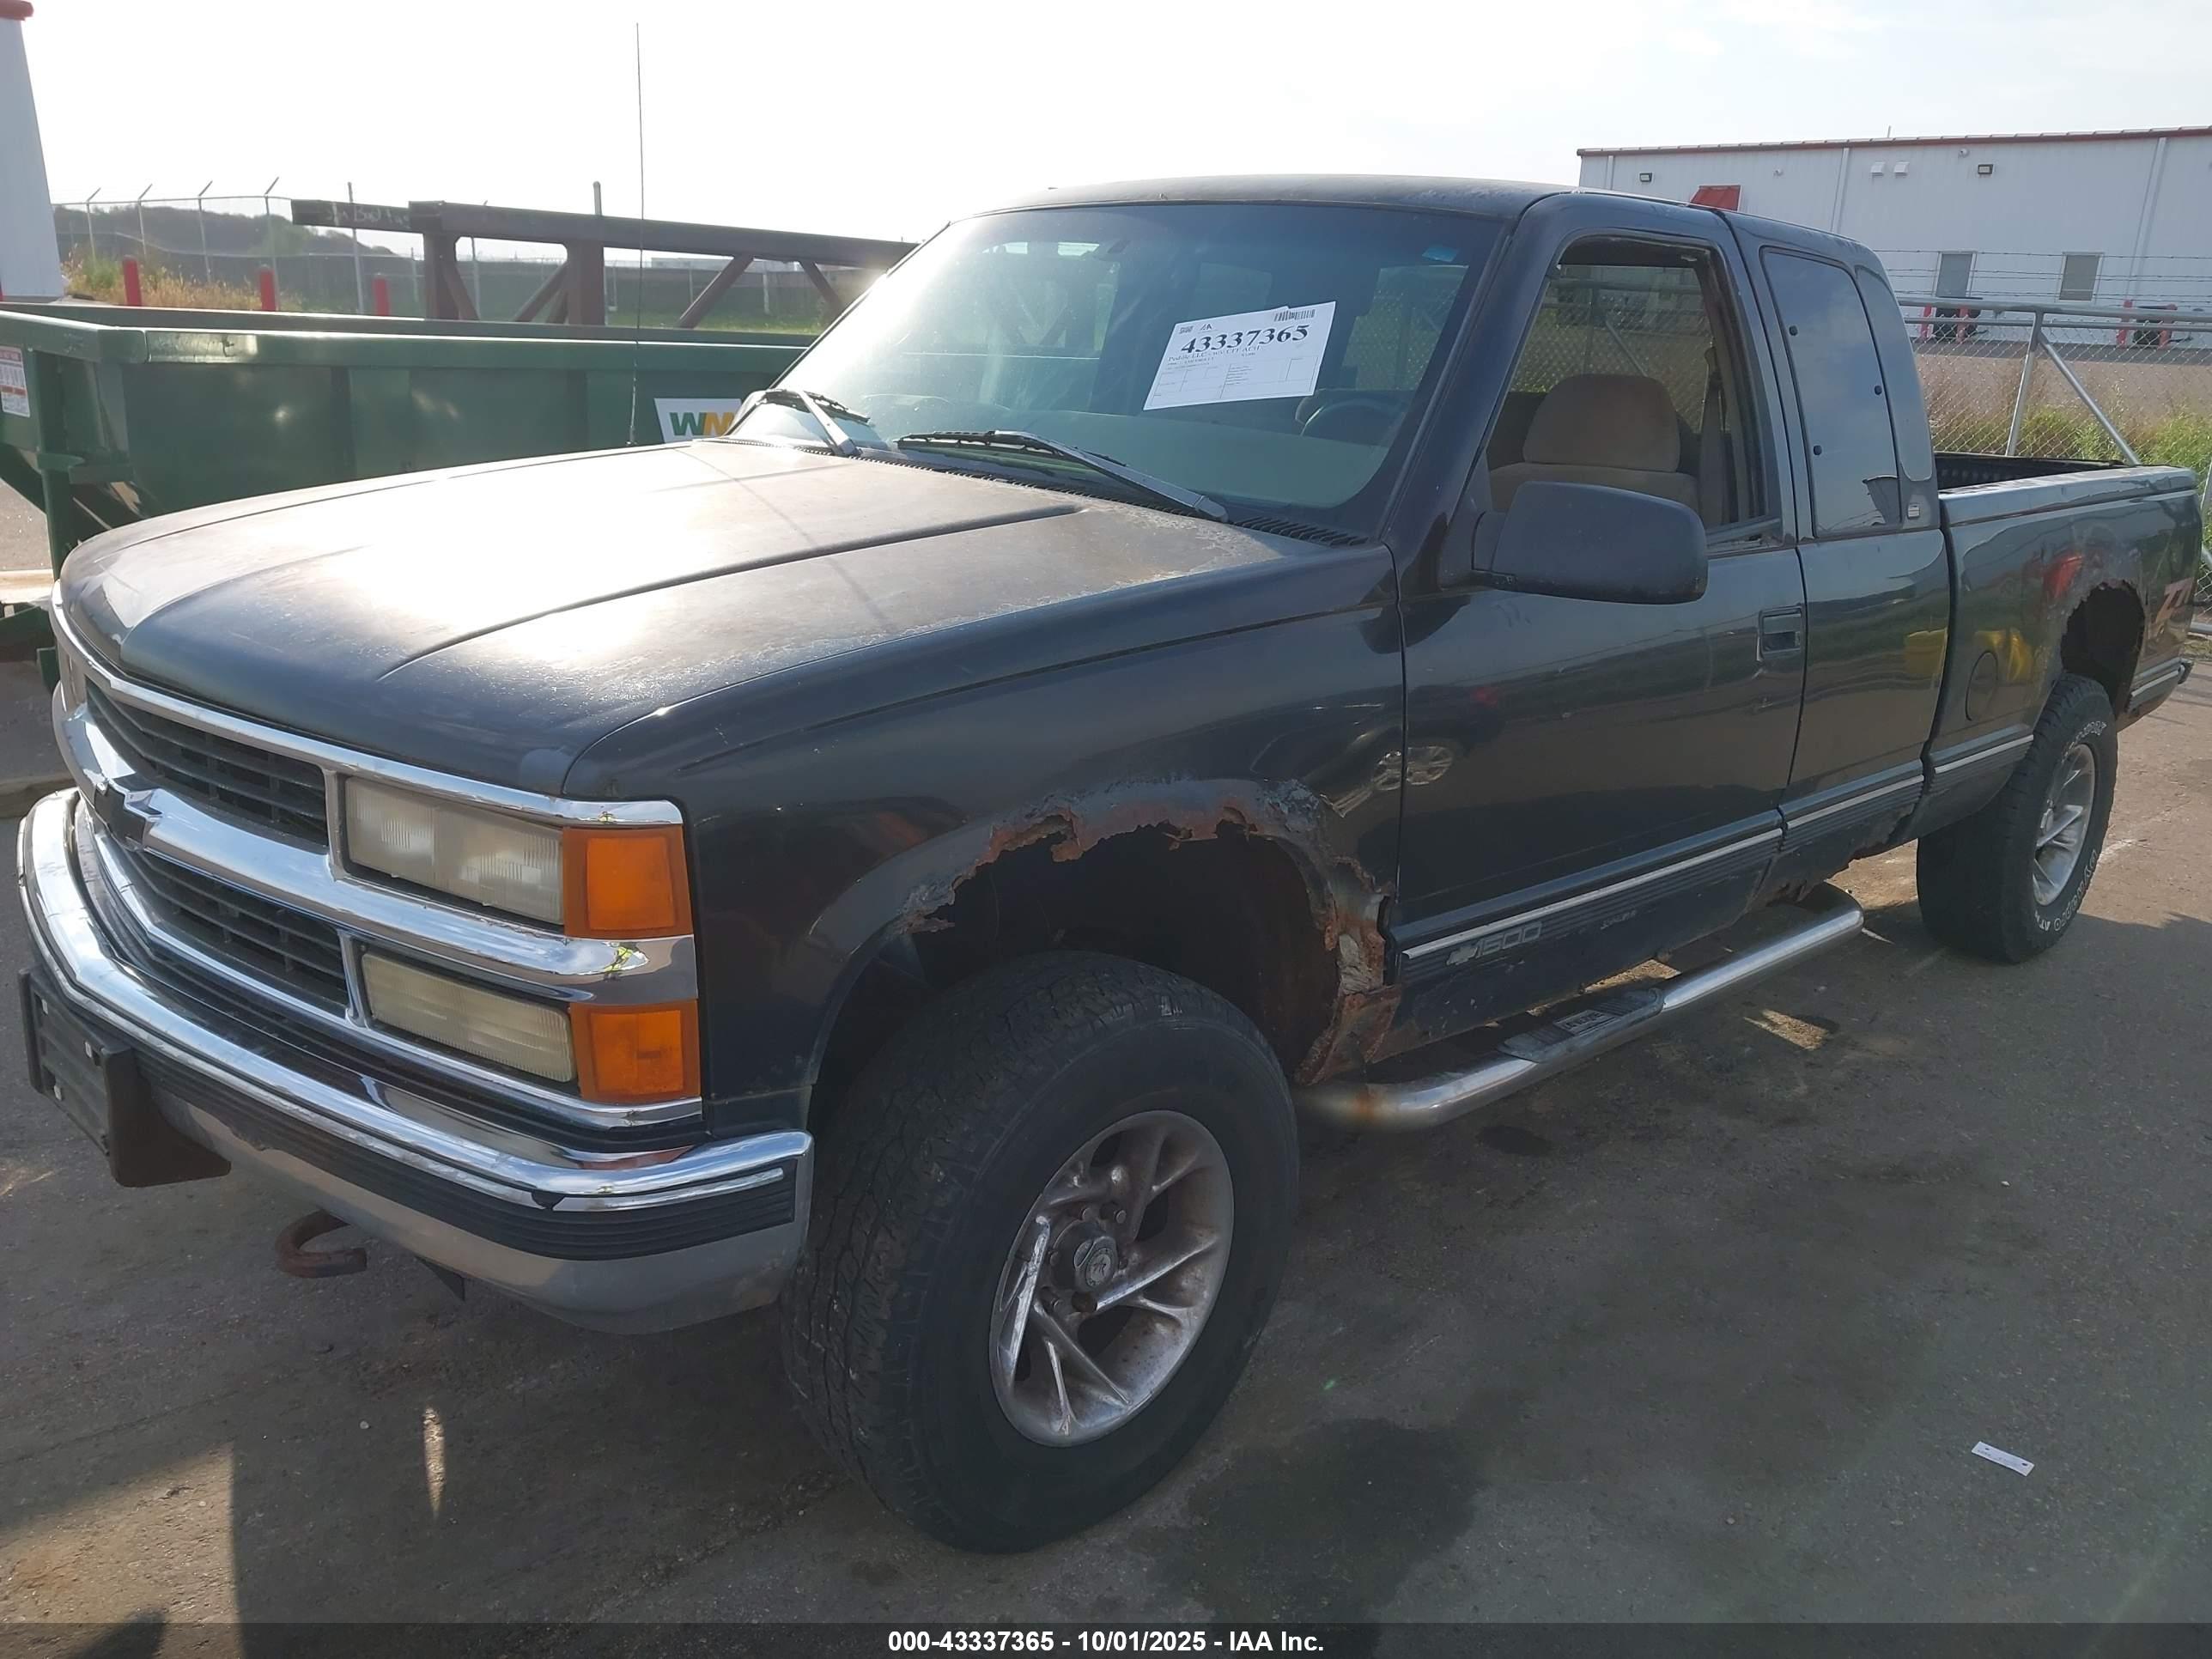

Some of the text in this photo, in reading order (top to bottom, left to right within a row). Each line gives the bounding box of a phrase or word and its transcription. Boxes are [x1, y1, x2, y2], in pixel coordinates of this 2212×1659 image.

[1181, 324, 1310, 354] 43337365
[669, 411, 735, 438] WM
[1475, 921, 1543, 959] 1500
